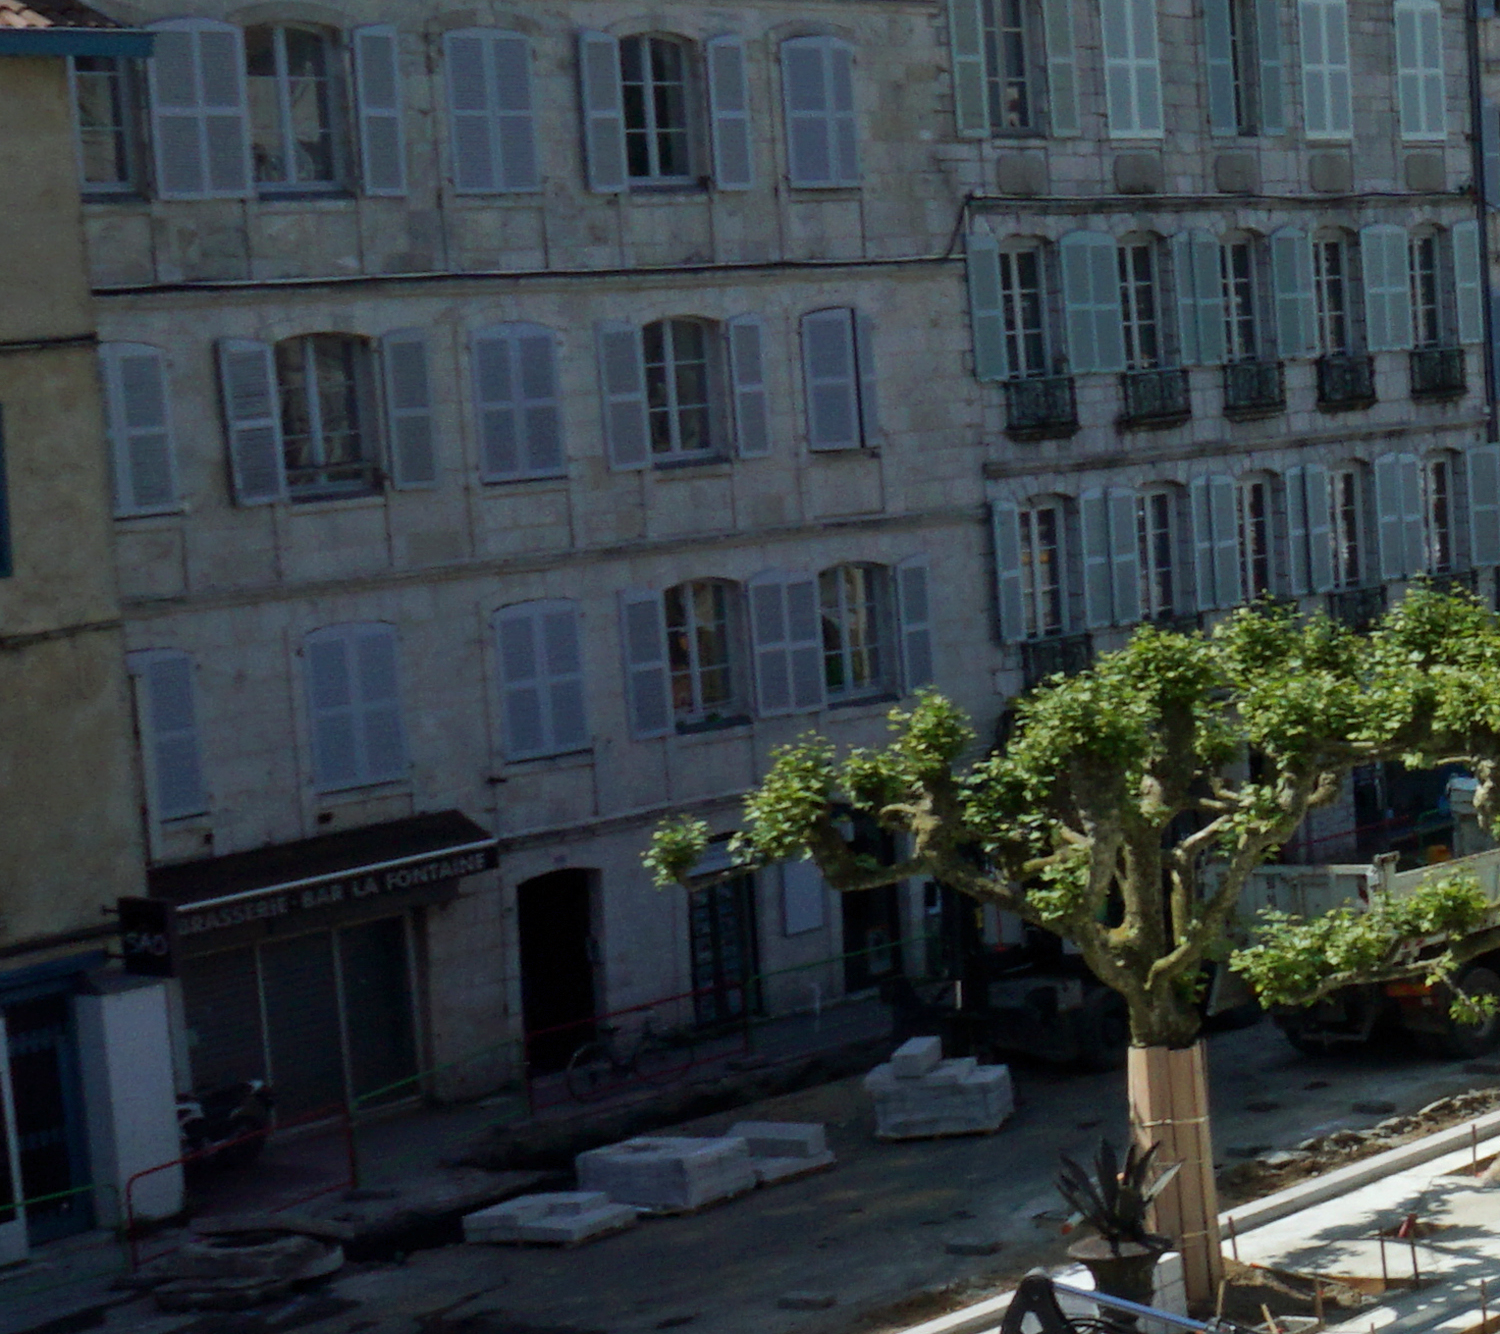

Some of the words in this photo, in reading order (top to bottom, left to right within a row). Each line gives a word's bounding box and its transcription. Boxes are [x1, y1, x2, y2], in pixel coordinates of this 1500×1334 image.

[177, 899, 289, 936] BRASSERIE
[300, 884, 344, 910] BAR
[351, 876, 380, 899] LA
[385, 852, 486, 891] FONTAINE
